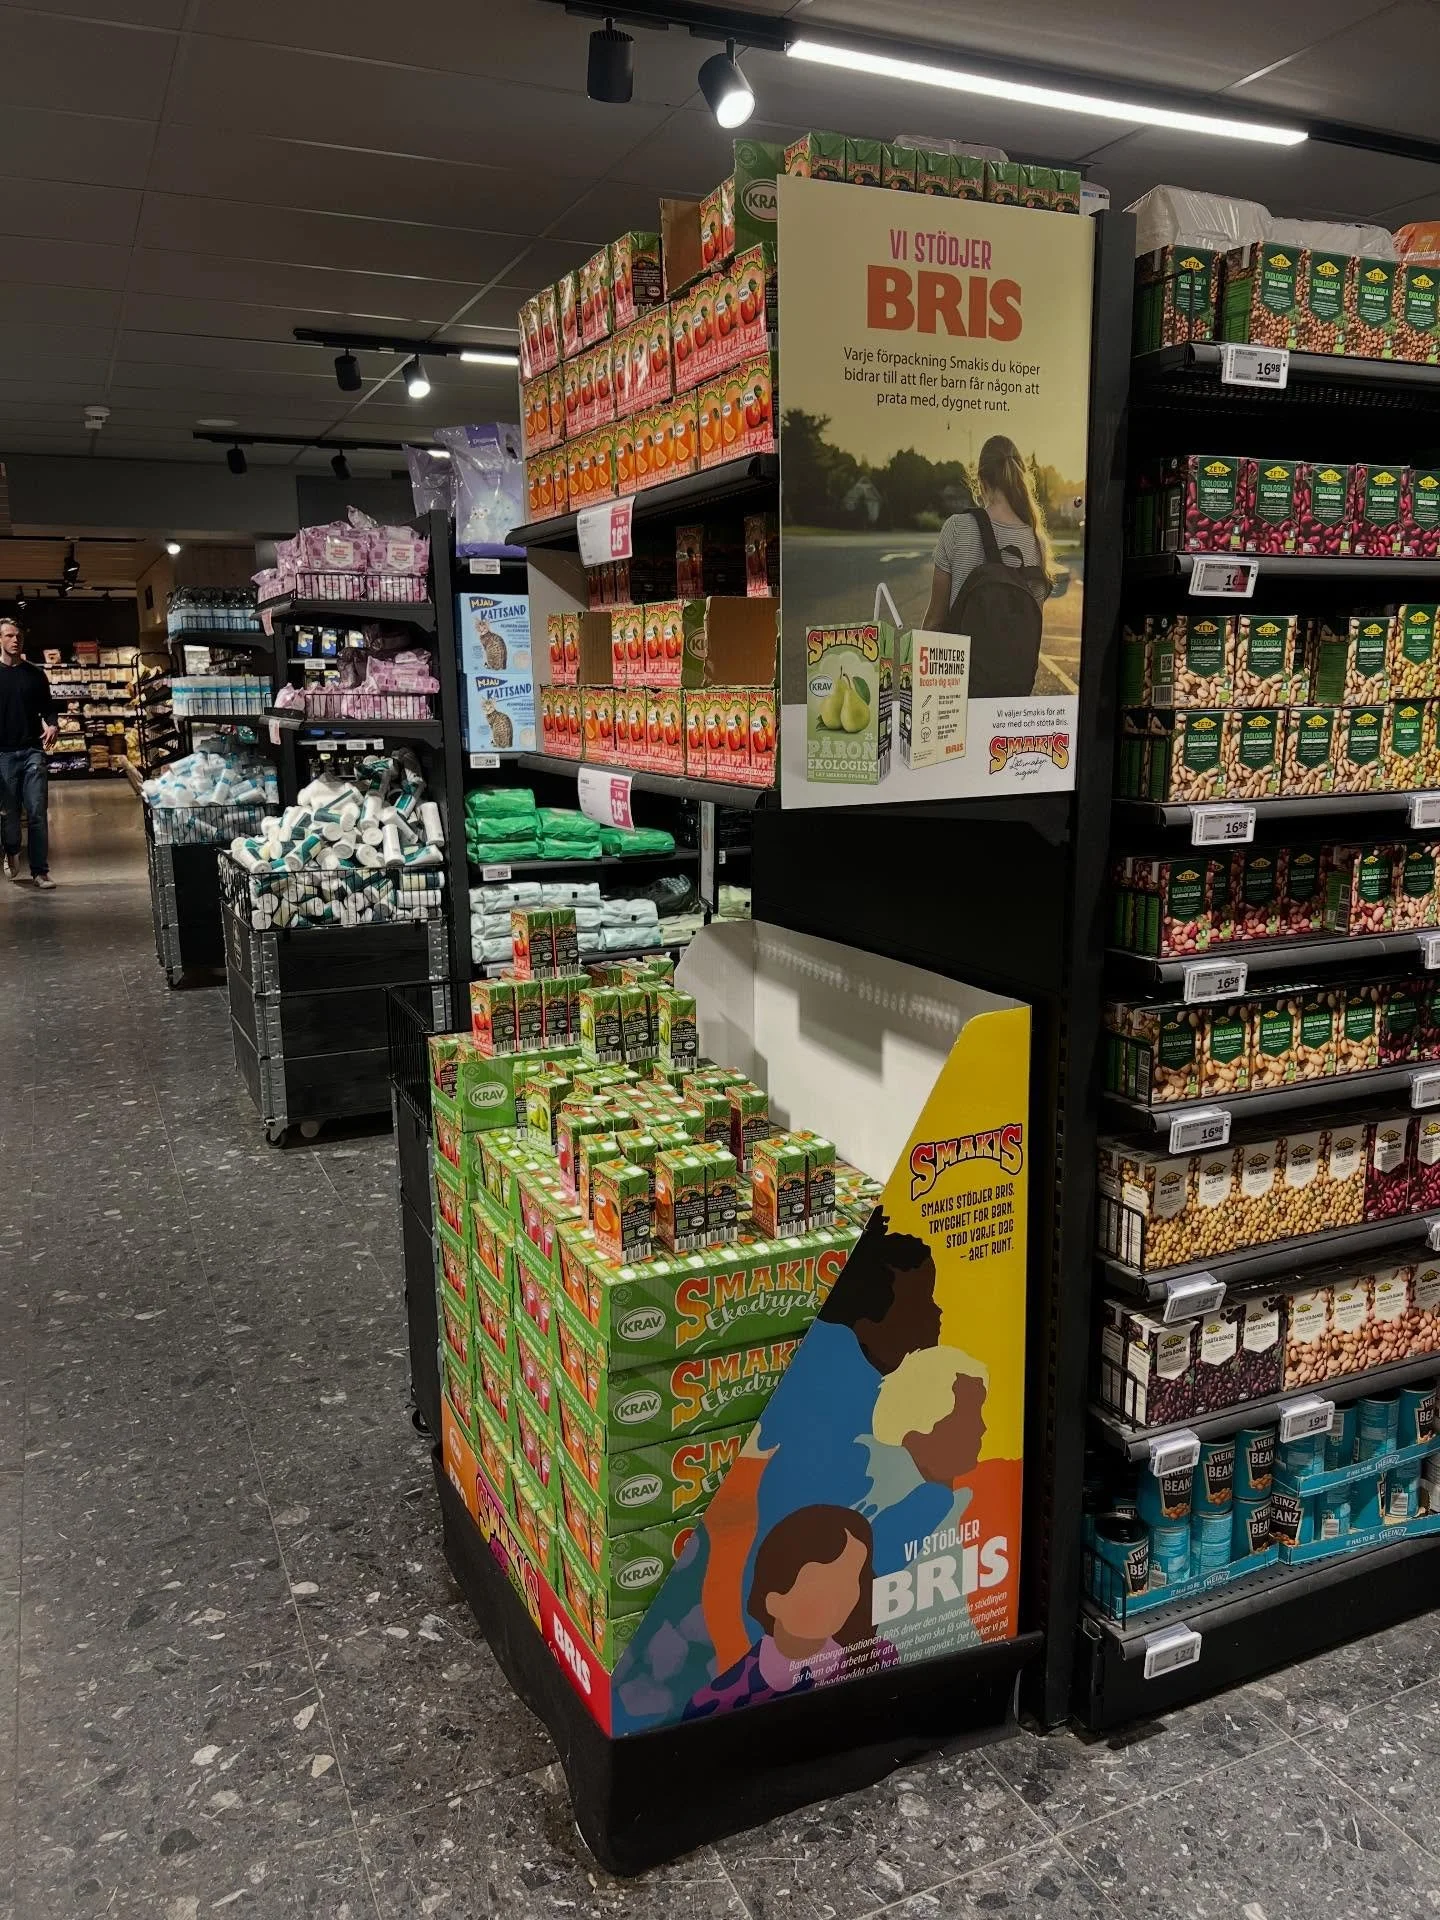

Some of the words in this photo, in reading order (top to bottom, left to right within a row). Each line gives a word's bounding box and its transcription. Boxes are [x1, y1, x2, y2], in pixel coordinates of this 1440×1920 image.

[748, 193, 777, 210] KRA
[890, 229, 907, 261] VI
[915, 231, 992, 270] STÖDJER
[1273, 257, 1287, 266] ZETA
[1184, 260, 1200, 268] ZETA
[1321, 265, 1335, 273] ZETA
[867, 264, 1023, 342] BRIS
[844, 346, 874, 365] Varje
[877, 348, 947, 371] förpackning
[950, 356, 989, 372] Smakis
[992, 359, 1006, 373] du
[1009, 360, 1041, 377] köper
[844, 367, 880, 383] bidrar
[883, 370, 897, 384] till
[900, 374, 916, 386] att
[919, 372, 938, 388] fler
[940, 375, 967, 389] barn
[969, 376, 984, 391] får
[987, 379, 1022, 395] någon
[1024, 382, 1040, 395] att
[877, 392, 907, 406] prata
[910, 394, 939, 409] med,
[941, 395, 982, 412] dygnet
[984, 399, 1010, 412] runt.
[471, 600, 494, 608] MJAU
[481, 604, 527, 620] KATTSAND
[808, 625, 879, 666] SMAKIS
[929, 648, 965, 661] MINUTERS
[920, 647, 929, 675] 5
[477, 679, 500, 687] MJAU
[487, 683, 532, 699] KATTSAND
[812, 682, 833, 691] KRAV
[997, 709, 1003, 718] Vi
[1023, 708, 1046, 717] Smakis
[1008, 720, 1022, 728] med
[945, 743, 964, 755] BRIS
[989, 732, 1070, 775] SMAKIS
[808, 758, 877, 772] EKOLOGISK
[474, 1088, 506, 1105] KRAV
[910, 1123, 1024, 1201] SMAKIS
[921, 1197, 954, 1217] SMAKIS
[956, 1189, 993, 1211] STÖDJER
[996, 1182, 1015, 1199] BRIS.
[929, 1211, 972, 1234] TRYGGHET
[974, 1207, 989, 1223] FÖR
[946, 1231, 968, 1248] STÖD
[992, 1237, 1014, 1254] RUNT.
[676, 1249, 849, 1349] SMAKIS
[705, 1288, 822, 1332] Ekodryck
[622, 1314, 662, 1338] KRAV
[671, 1338, 801, 1434] SMAK
[618, 1398, 661, 1423] KRAV
[1208, 1465, 1234, 1478] BEAN
[620, 1482, 660, 1506] KRAV
[1273, 1494, 1298, 1510] EINZ
[904, 1541, 918, 1562] VI
[922, 1519, 980, 1556] STÖDJER
[1382, 1527, 1405, 1539] HEINZ
[621, 1562, 662, 1586] KRAV
[872, 1535, 1009, 1627] BRIS
[1205, 1572, 1230, 1586] HEINZ
[883, 1627, 900, 1640] BRIS
[901, 1621, 921, 1637] driver
[922, 1616, 938, 1628] den
[553, 1612, 591, 1695] BRIS
[805, 1668, 824, 1681] barn
[825, 1661, 840, 1675] och
[840, 1652, 870, 1669] arbetar
[870, 1647, 882, 1660] för
[882, 1644, 895, 1655] att
[914, 1633, 932, 1646] barn
[932, 1626, 945, 1639] ska
[955, 1618, 970, 1631] sina
[866, 1662, 880, 1675] och
[880, 1658, 892, 1669] ha
[892, 1655, 902, 1667] en
[904, 1648, 923, 1661] trygg
[957, 1632, 969, 1644] Det
[970, 1624, 992, 1640] tycker
[992, 1622, 999, 1631] vi
